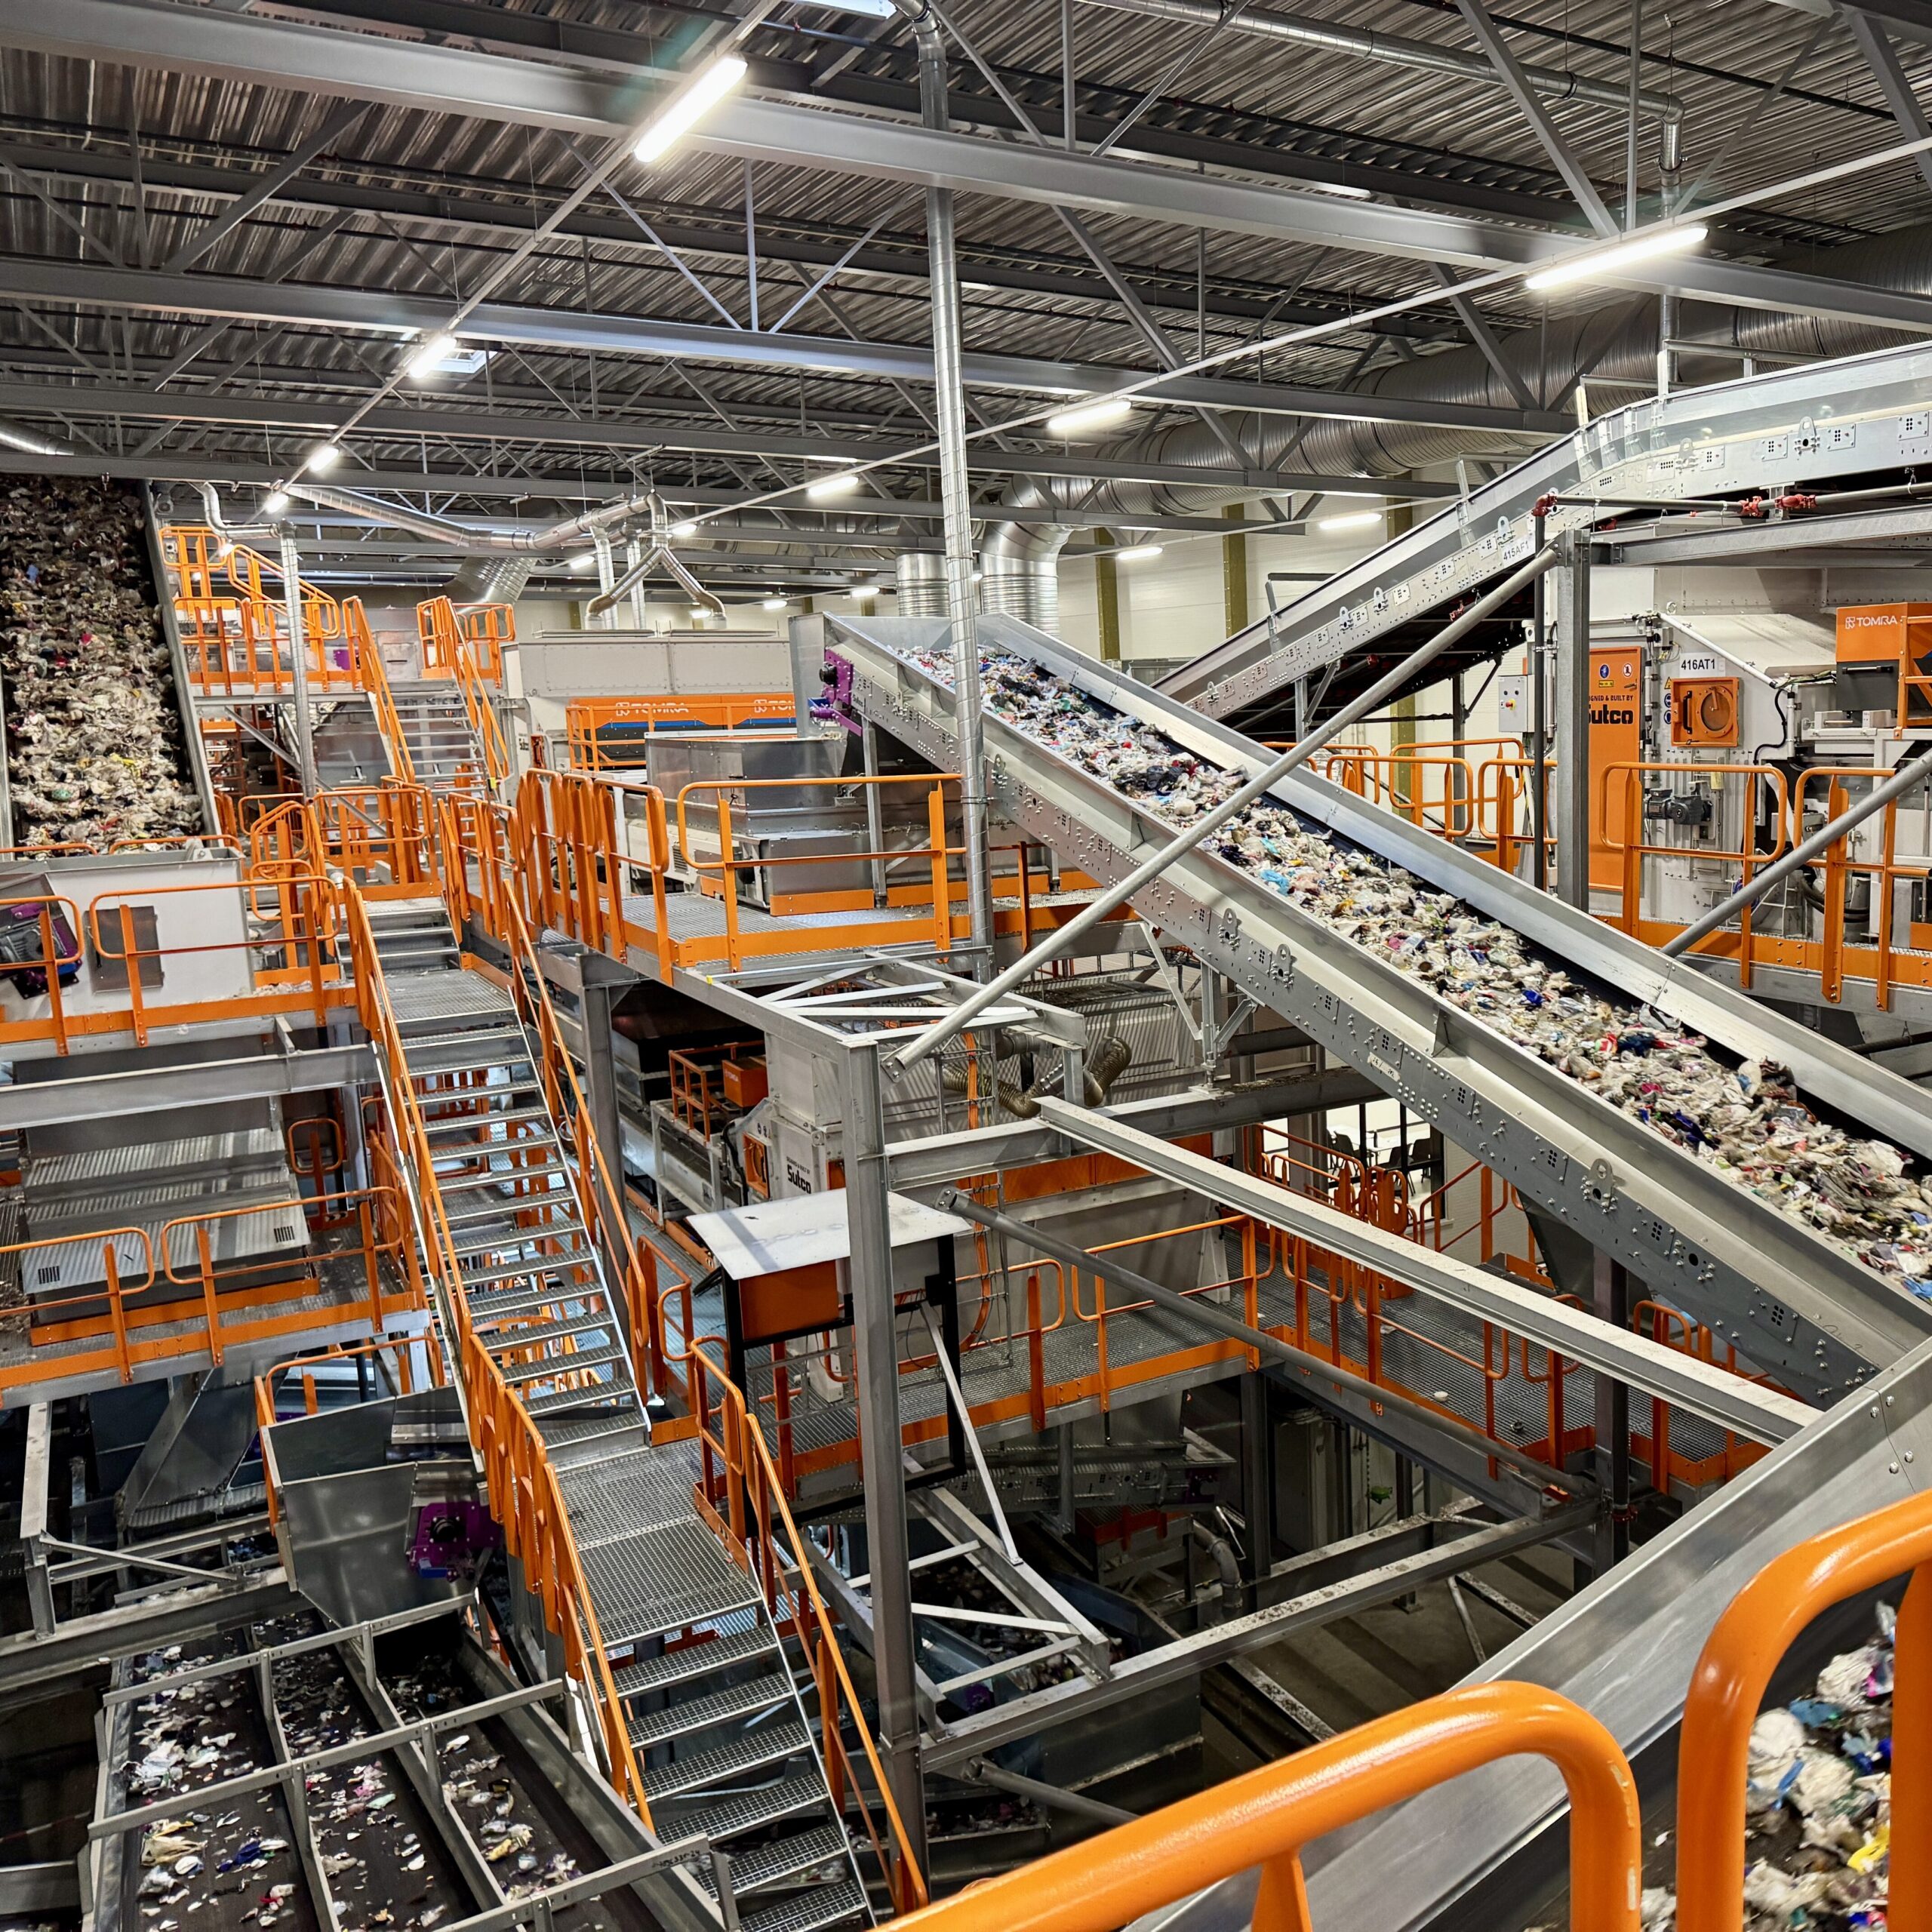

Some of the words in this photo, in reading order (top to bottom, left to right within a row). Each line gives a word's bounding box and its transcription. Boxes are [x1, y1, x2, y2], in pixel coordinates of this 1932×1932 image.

[1503, 540, 1529, 560] 415AF1
[1857, 616, 1898, 626] TOMRA
[1681, 658, 1715, 670] 416AT1
[1589, 704, 1633, 724] utco
[787, 1164, 811, 1194] Sutco
